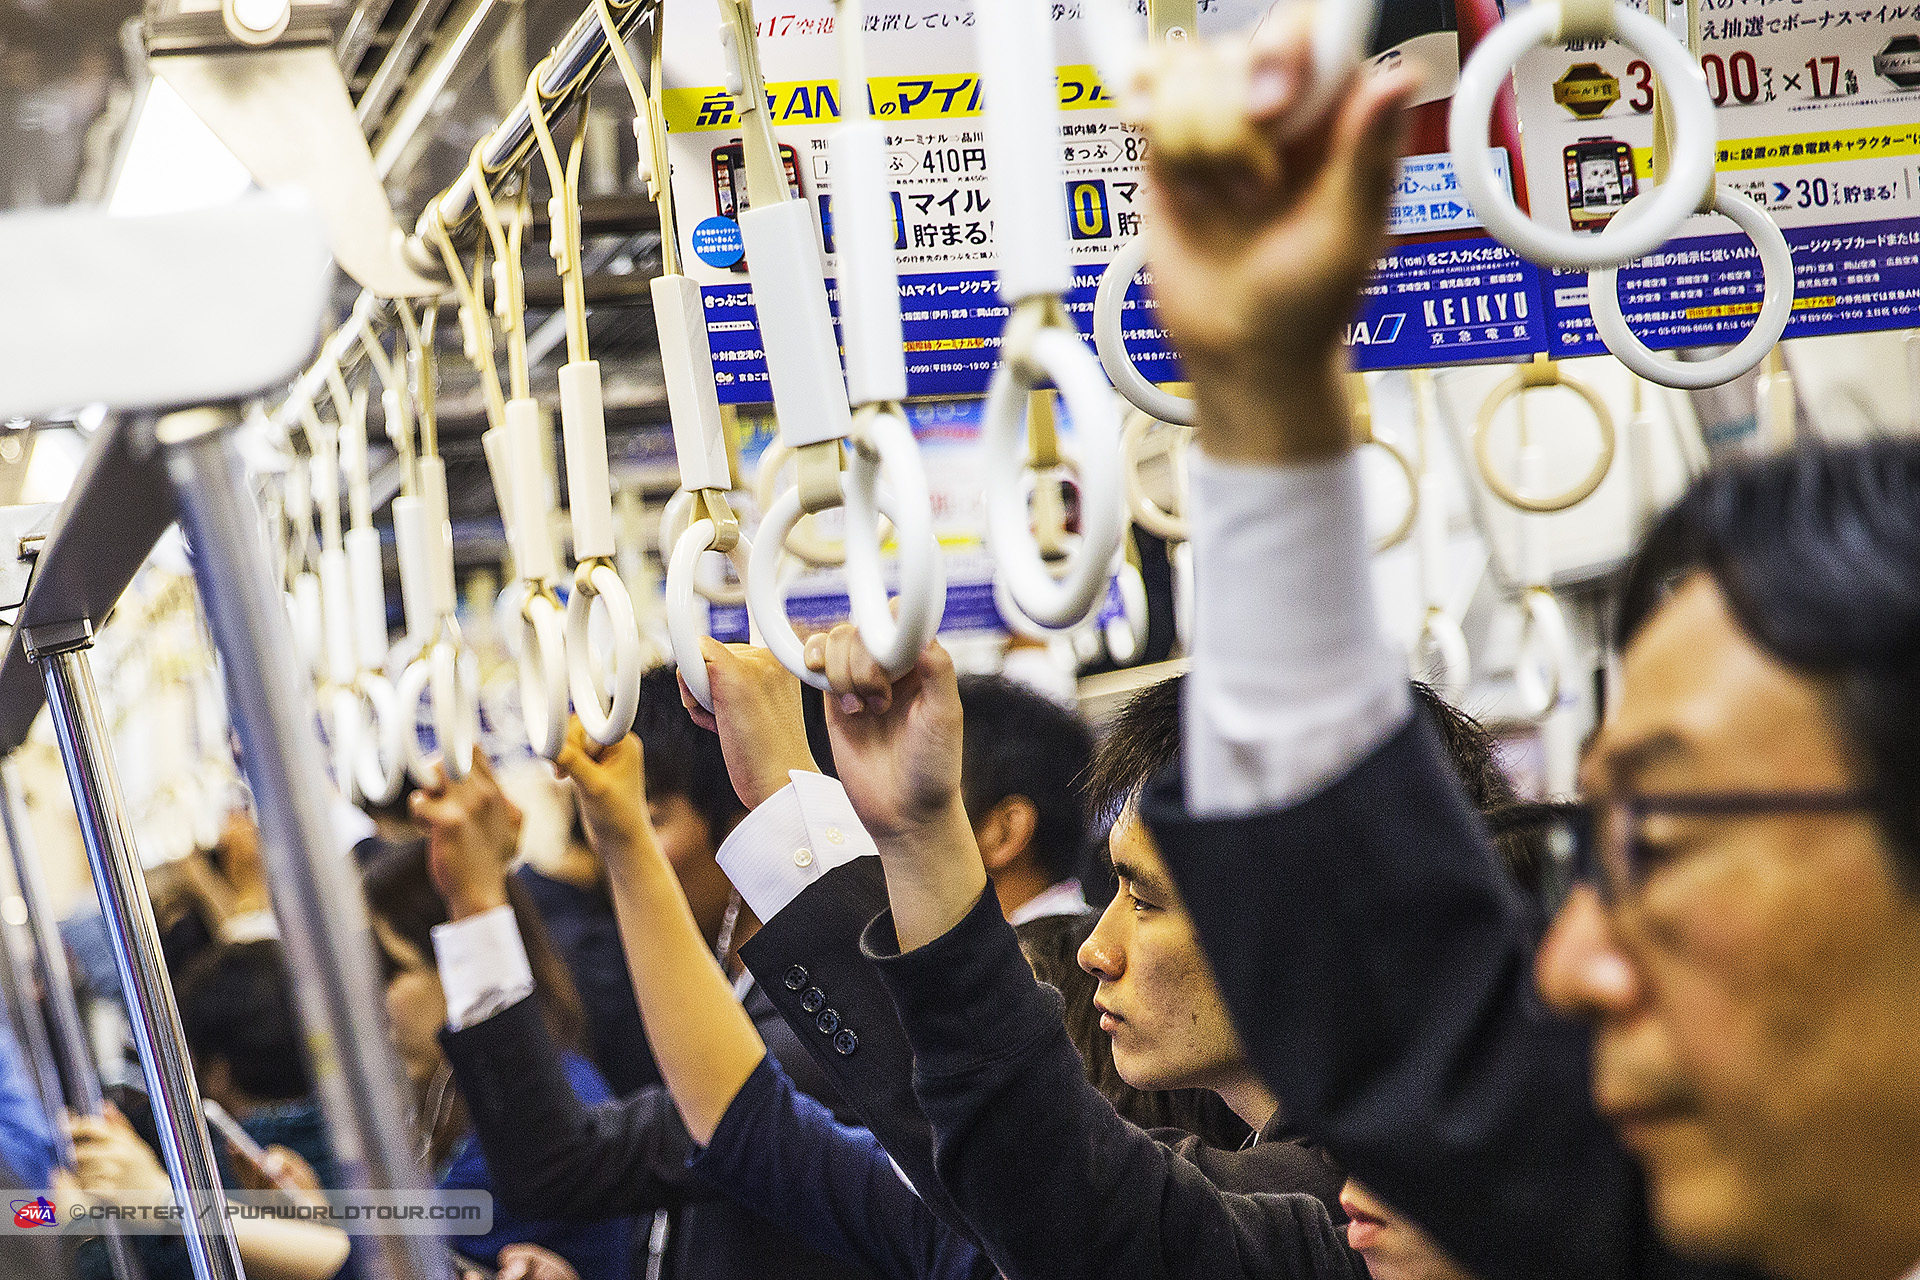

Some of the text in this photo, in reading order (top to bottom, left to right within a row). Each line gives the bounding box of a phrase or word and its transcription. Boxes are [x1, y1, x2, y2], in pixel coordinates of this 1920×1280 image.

[922, 148, 987, 174] 410円
[908, 188, 992, 217] マイル
[1795, 178, 1829, 208] 30
[1422, 291, 1529, 328] KEIKYU
